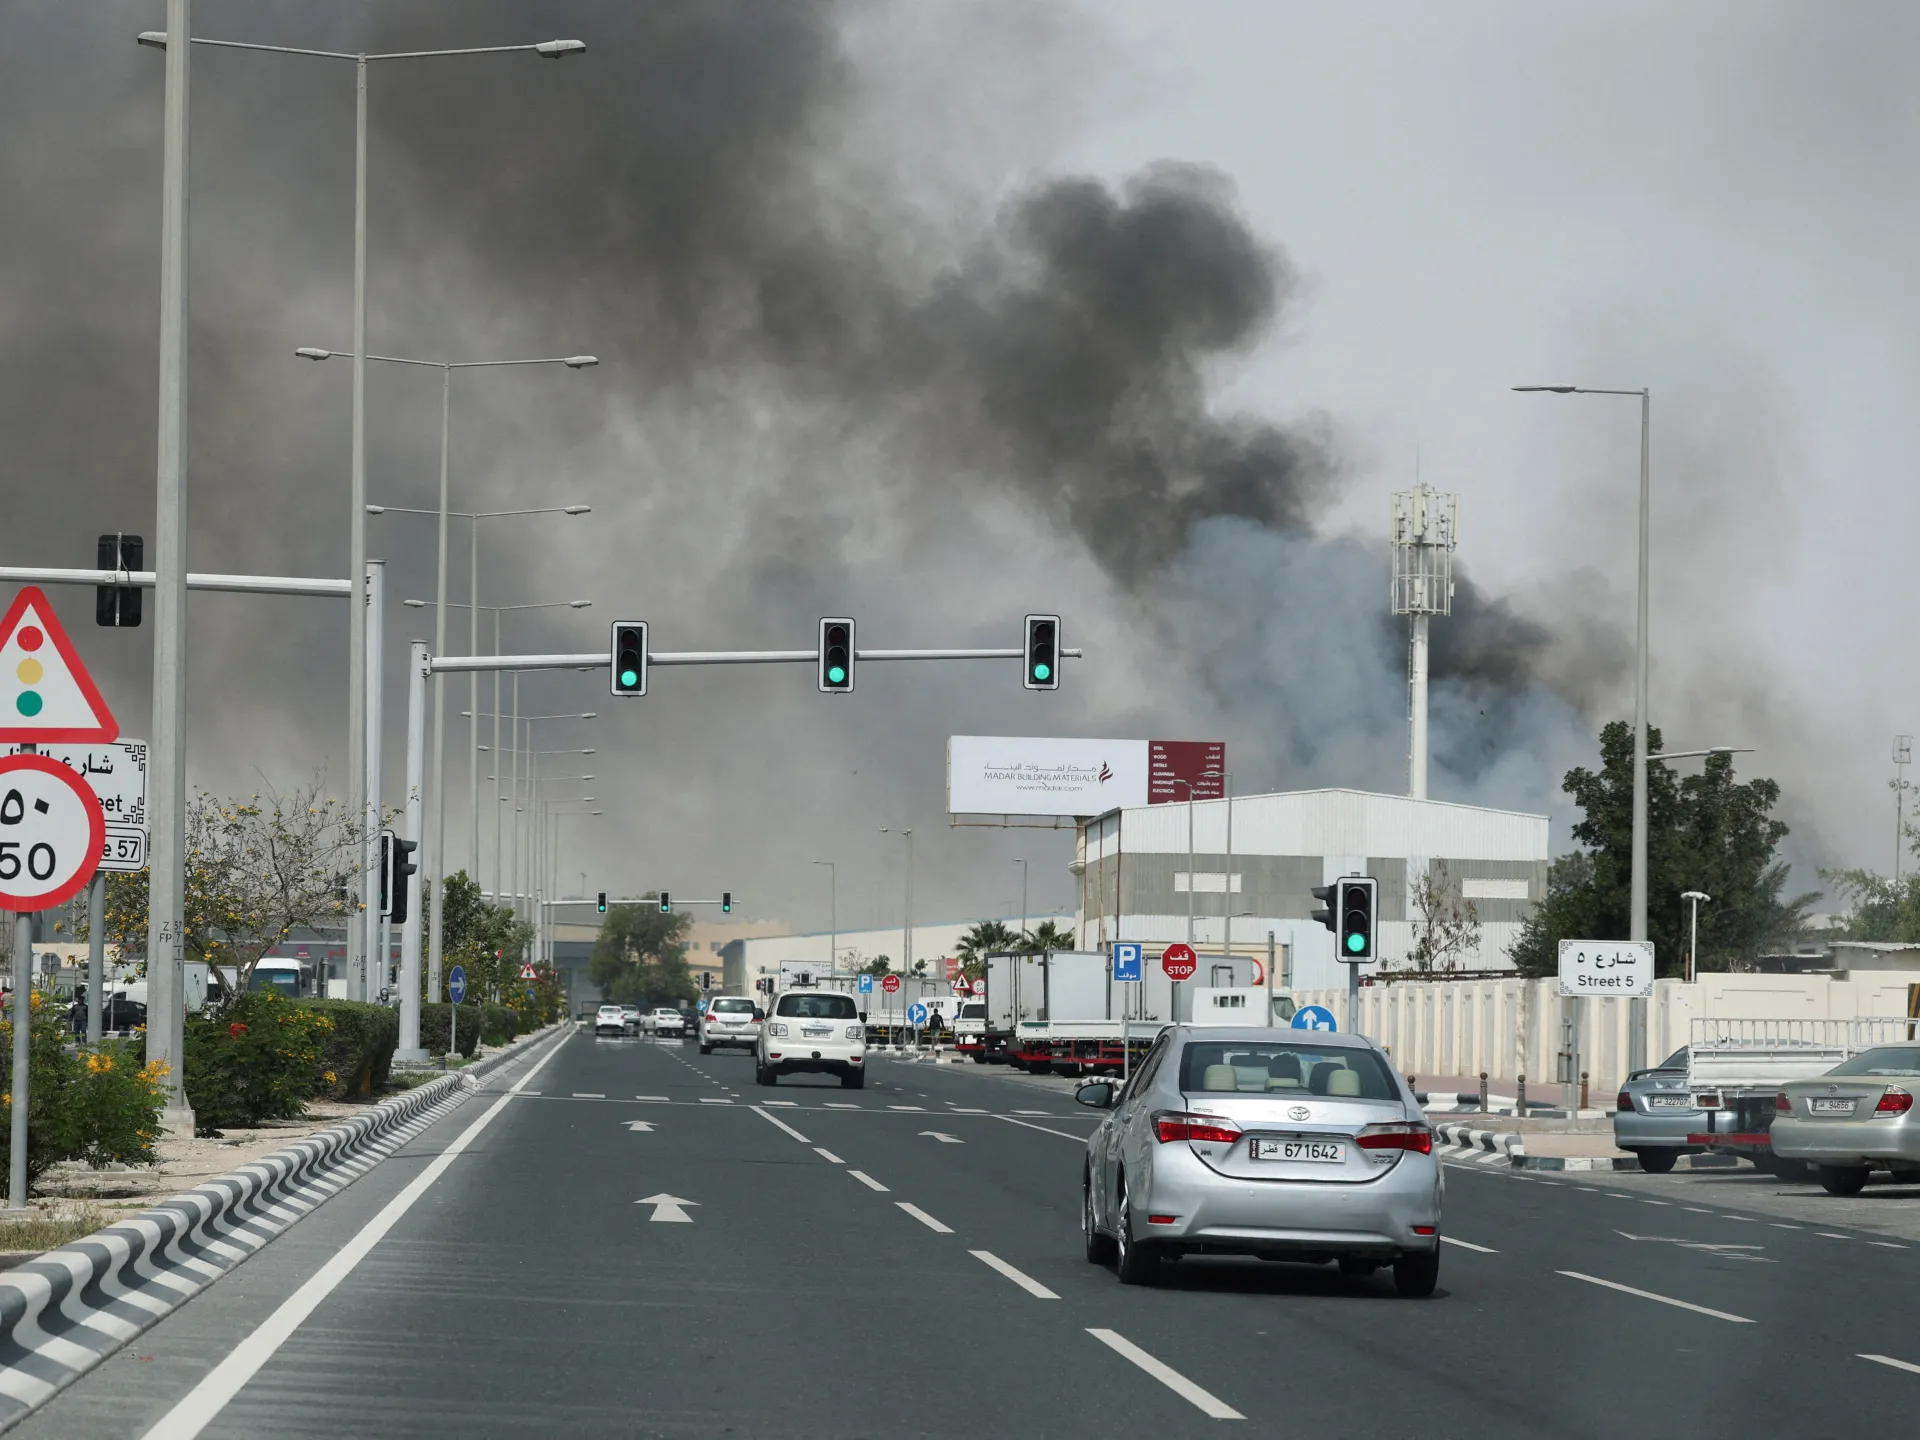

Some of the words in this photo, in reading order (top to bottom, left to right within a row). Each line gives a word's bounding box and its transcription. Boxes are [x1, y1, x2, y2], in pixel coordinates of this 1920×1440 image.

[984, 772, 1016, 780] MADAR
[1017, 773, 1052, 781] BUILDING
[1053, 774, 1097, 782] MATERIALS
[0, 788, 50, 825] ٥٠
[97, 794, 122, 812] eet
[117, 840, 138, 858] 57
[0, 842, 56, 881] 50
[1119, 946, 1136, 969] P
[1169, 951, 1189, 961] قف
[1577, 952, 1586, 963] ٥
[1595, 952, 1637, 969] شارع
[1167, 966, 1194, 975] STOP
[861, 976, 870, 988] P
[1578, 975, 1621, 987] Street
[1625, 976, 1634, 987] 5
[1664, 1097, 1689, 1106] 322707
[1829, 1100, 1849, 1109] 94656
[1284, 1143, 1339, 1159] 671642
